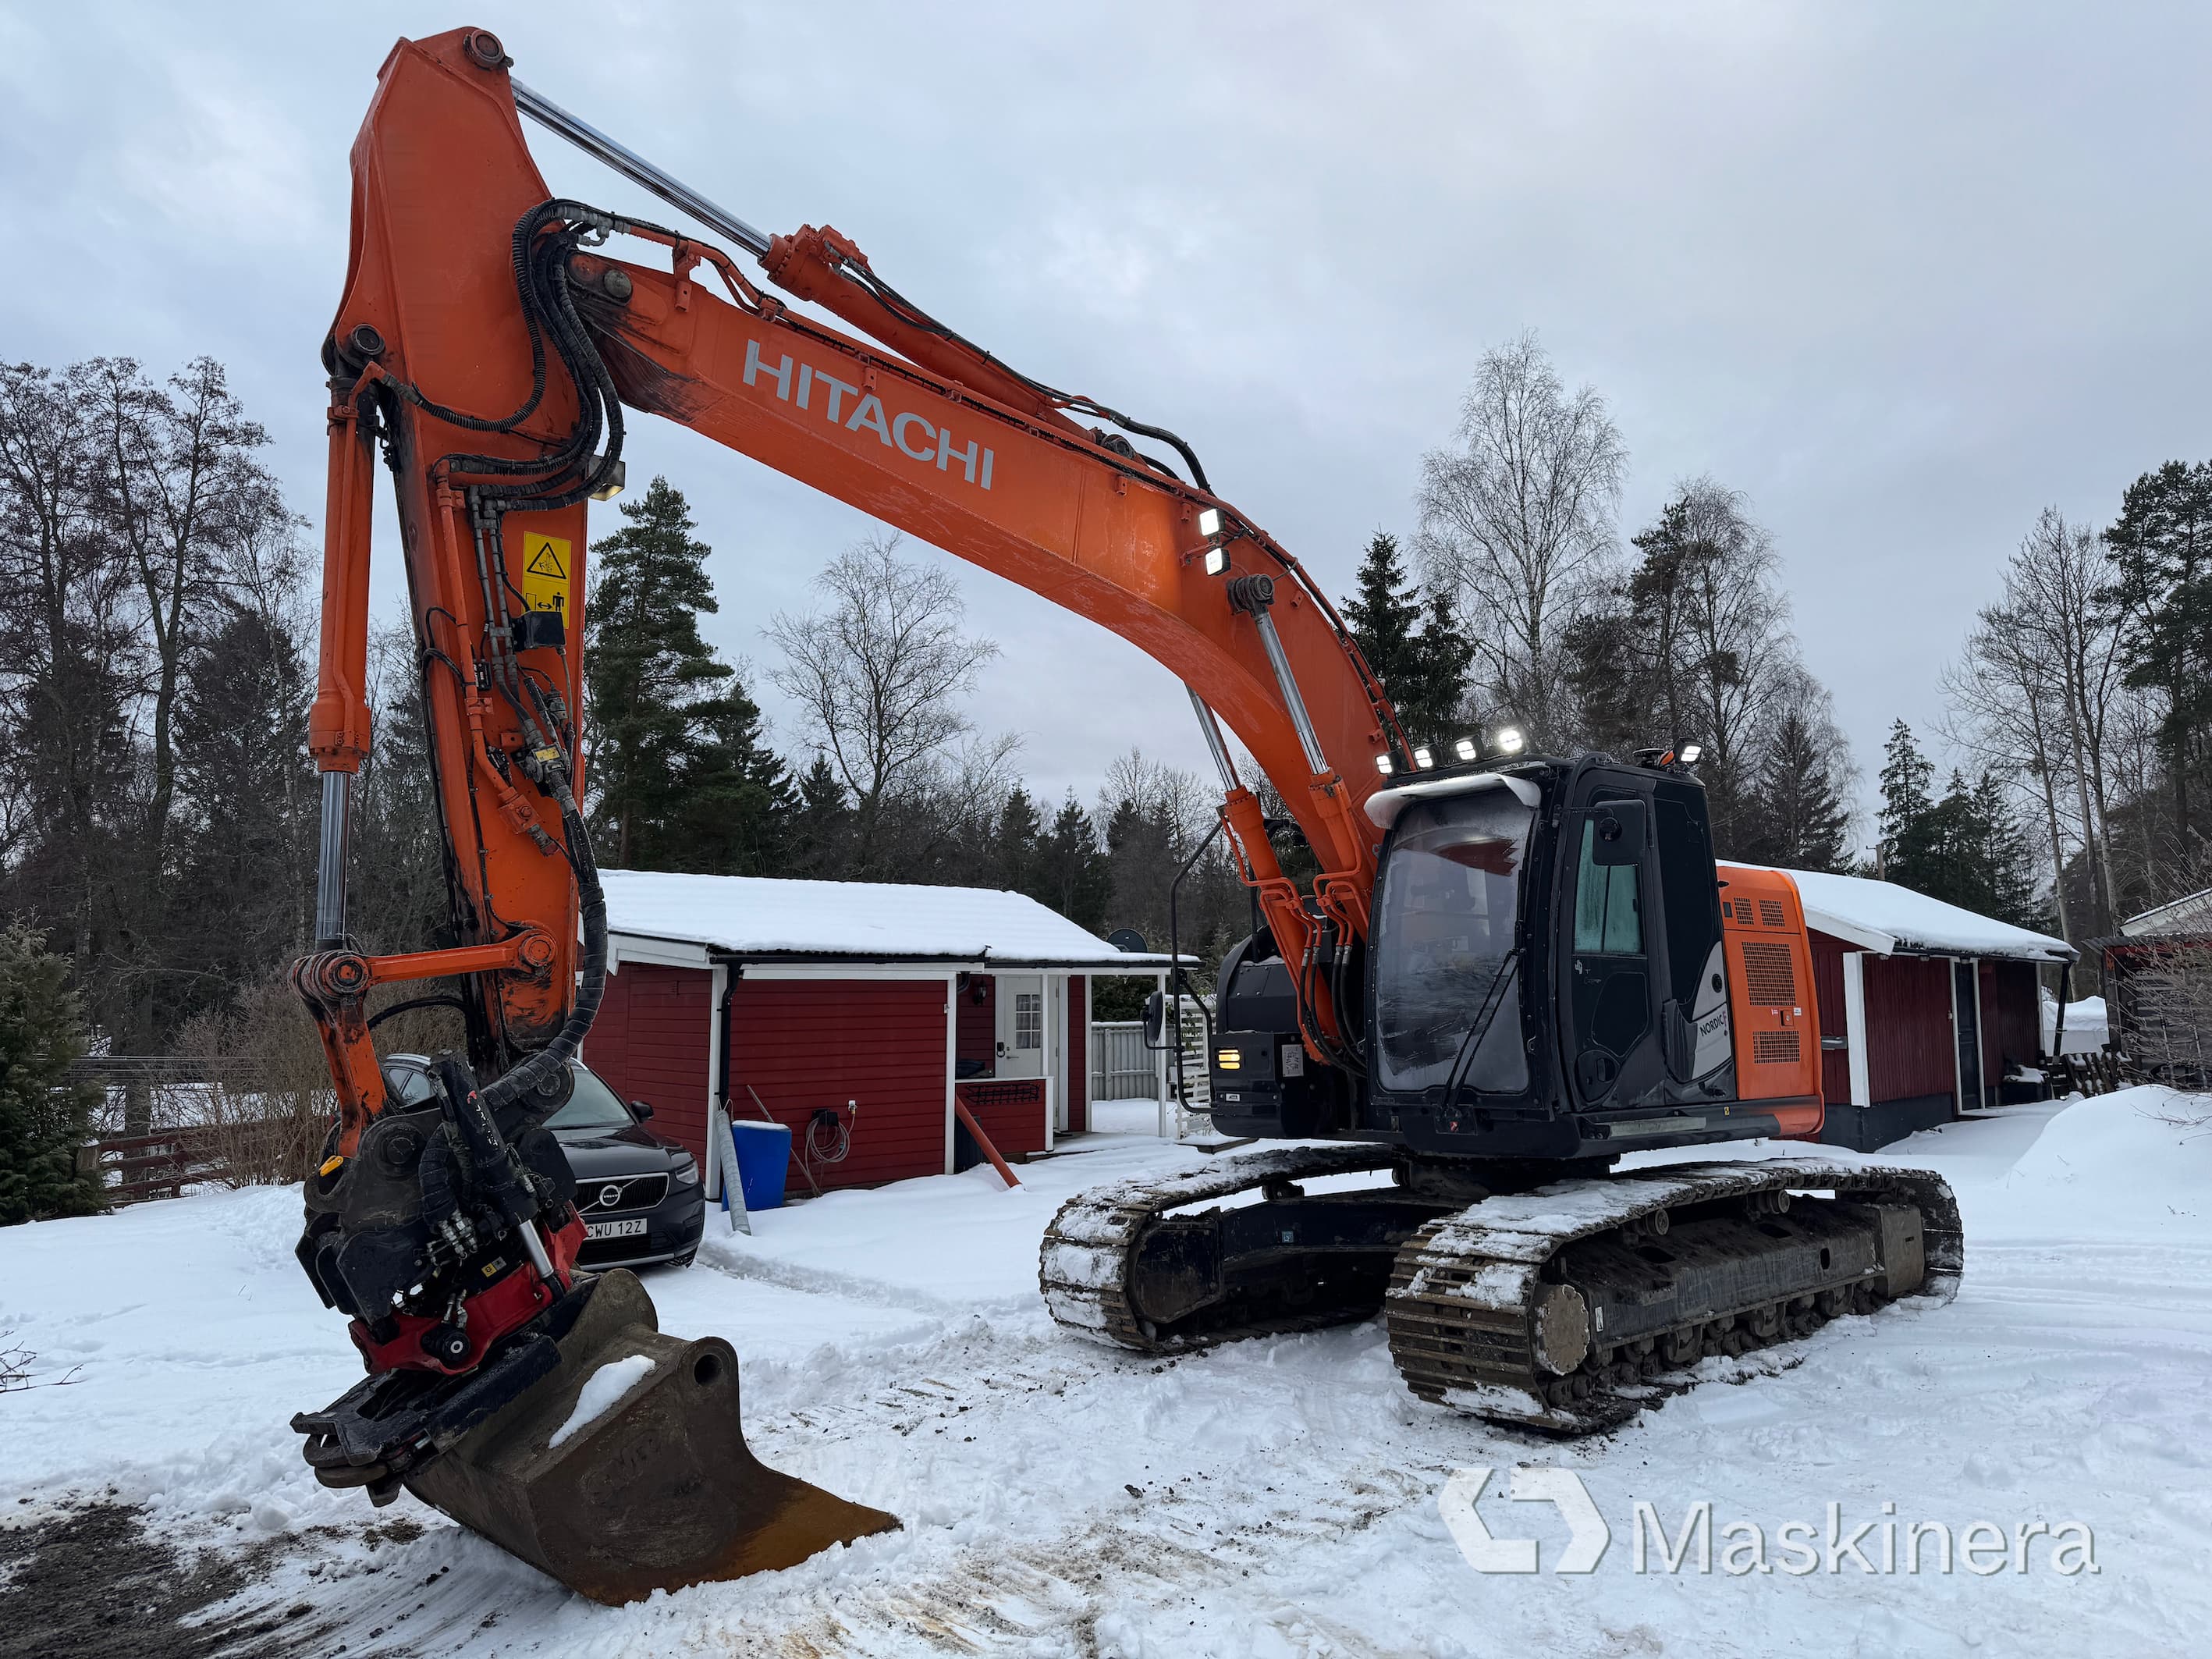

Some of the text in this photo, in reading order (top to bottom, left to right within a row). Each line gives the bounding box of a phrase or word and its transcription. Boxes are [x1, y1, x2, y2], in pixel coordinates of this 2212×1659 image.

[742, 339, 994, 490] HITACHI
[587, 1220, 641, 1238] CWU 12Z
